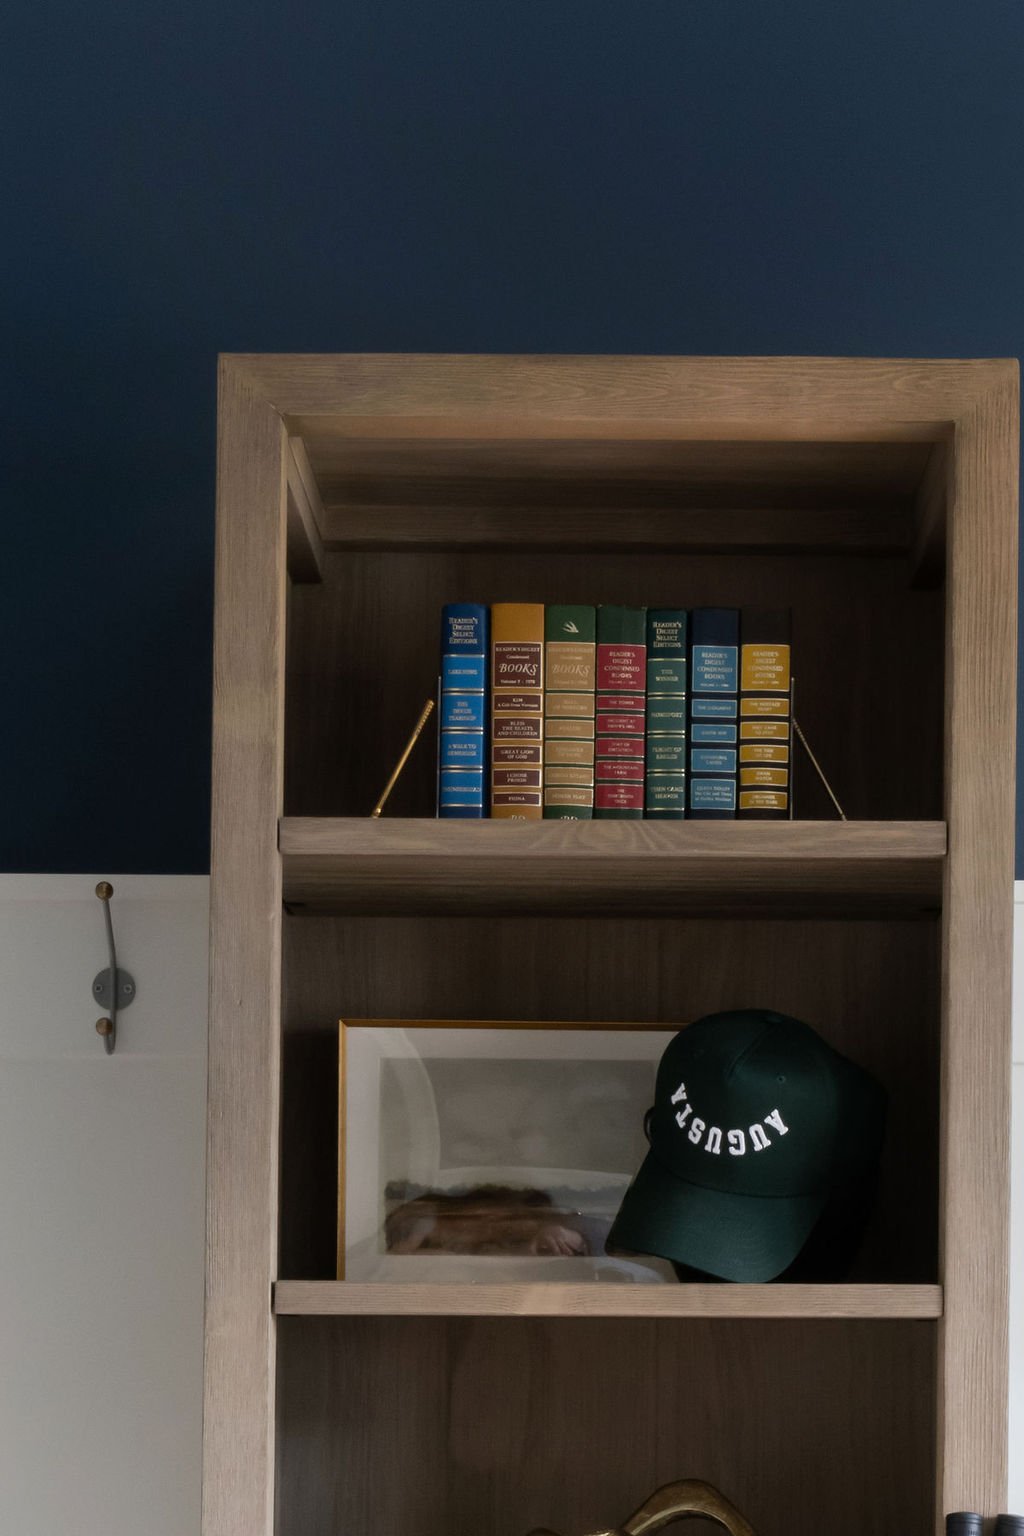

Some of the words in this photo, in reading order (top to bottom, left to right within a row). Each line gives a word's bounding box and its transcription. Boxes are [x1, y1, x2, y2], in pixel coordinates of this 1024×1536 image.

[499, 663, 539, 676] BOOKS
[552, 664, 591, 678] BOOKS
[671, 1082, 789, 1155] AUGUSTA
